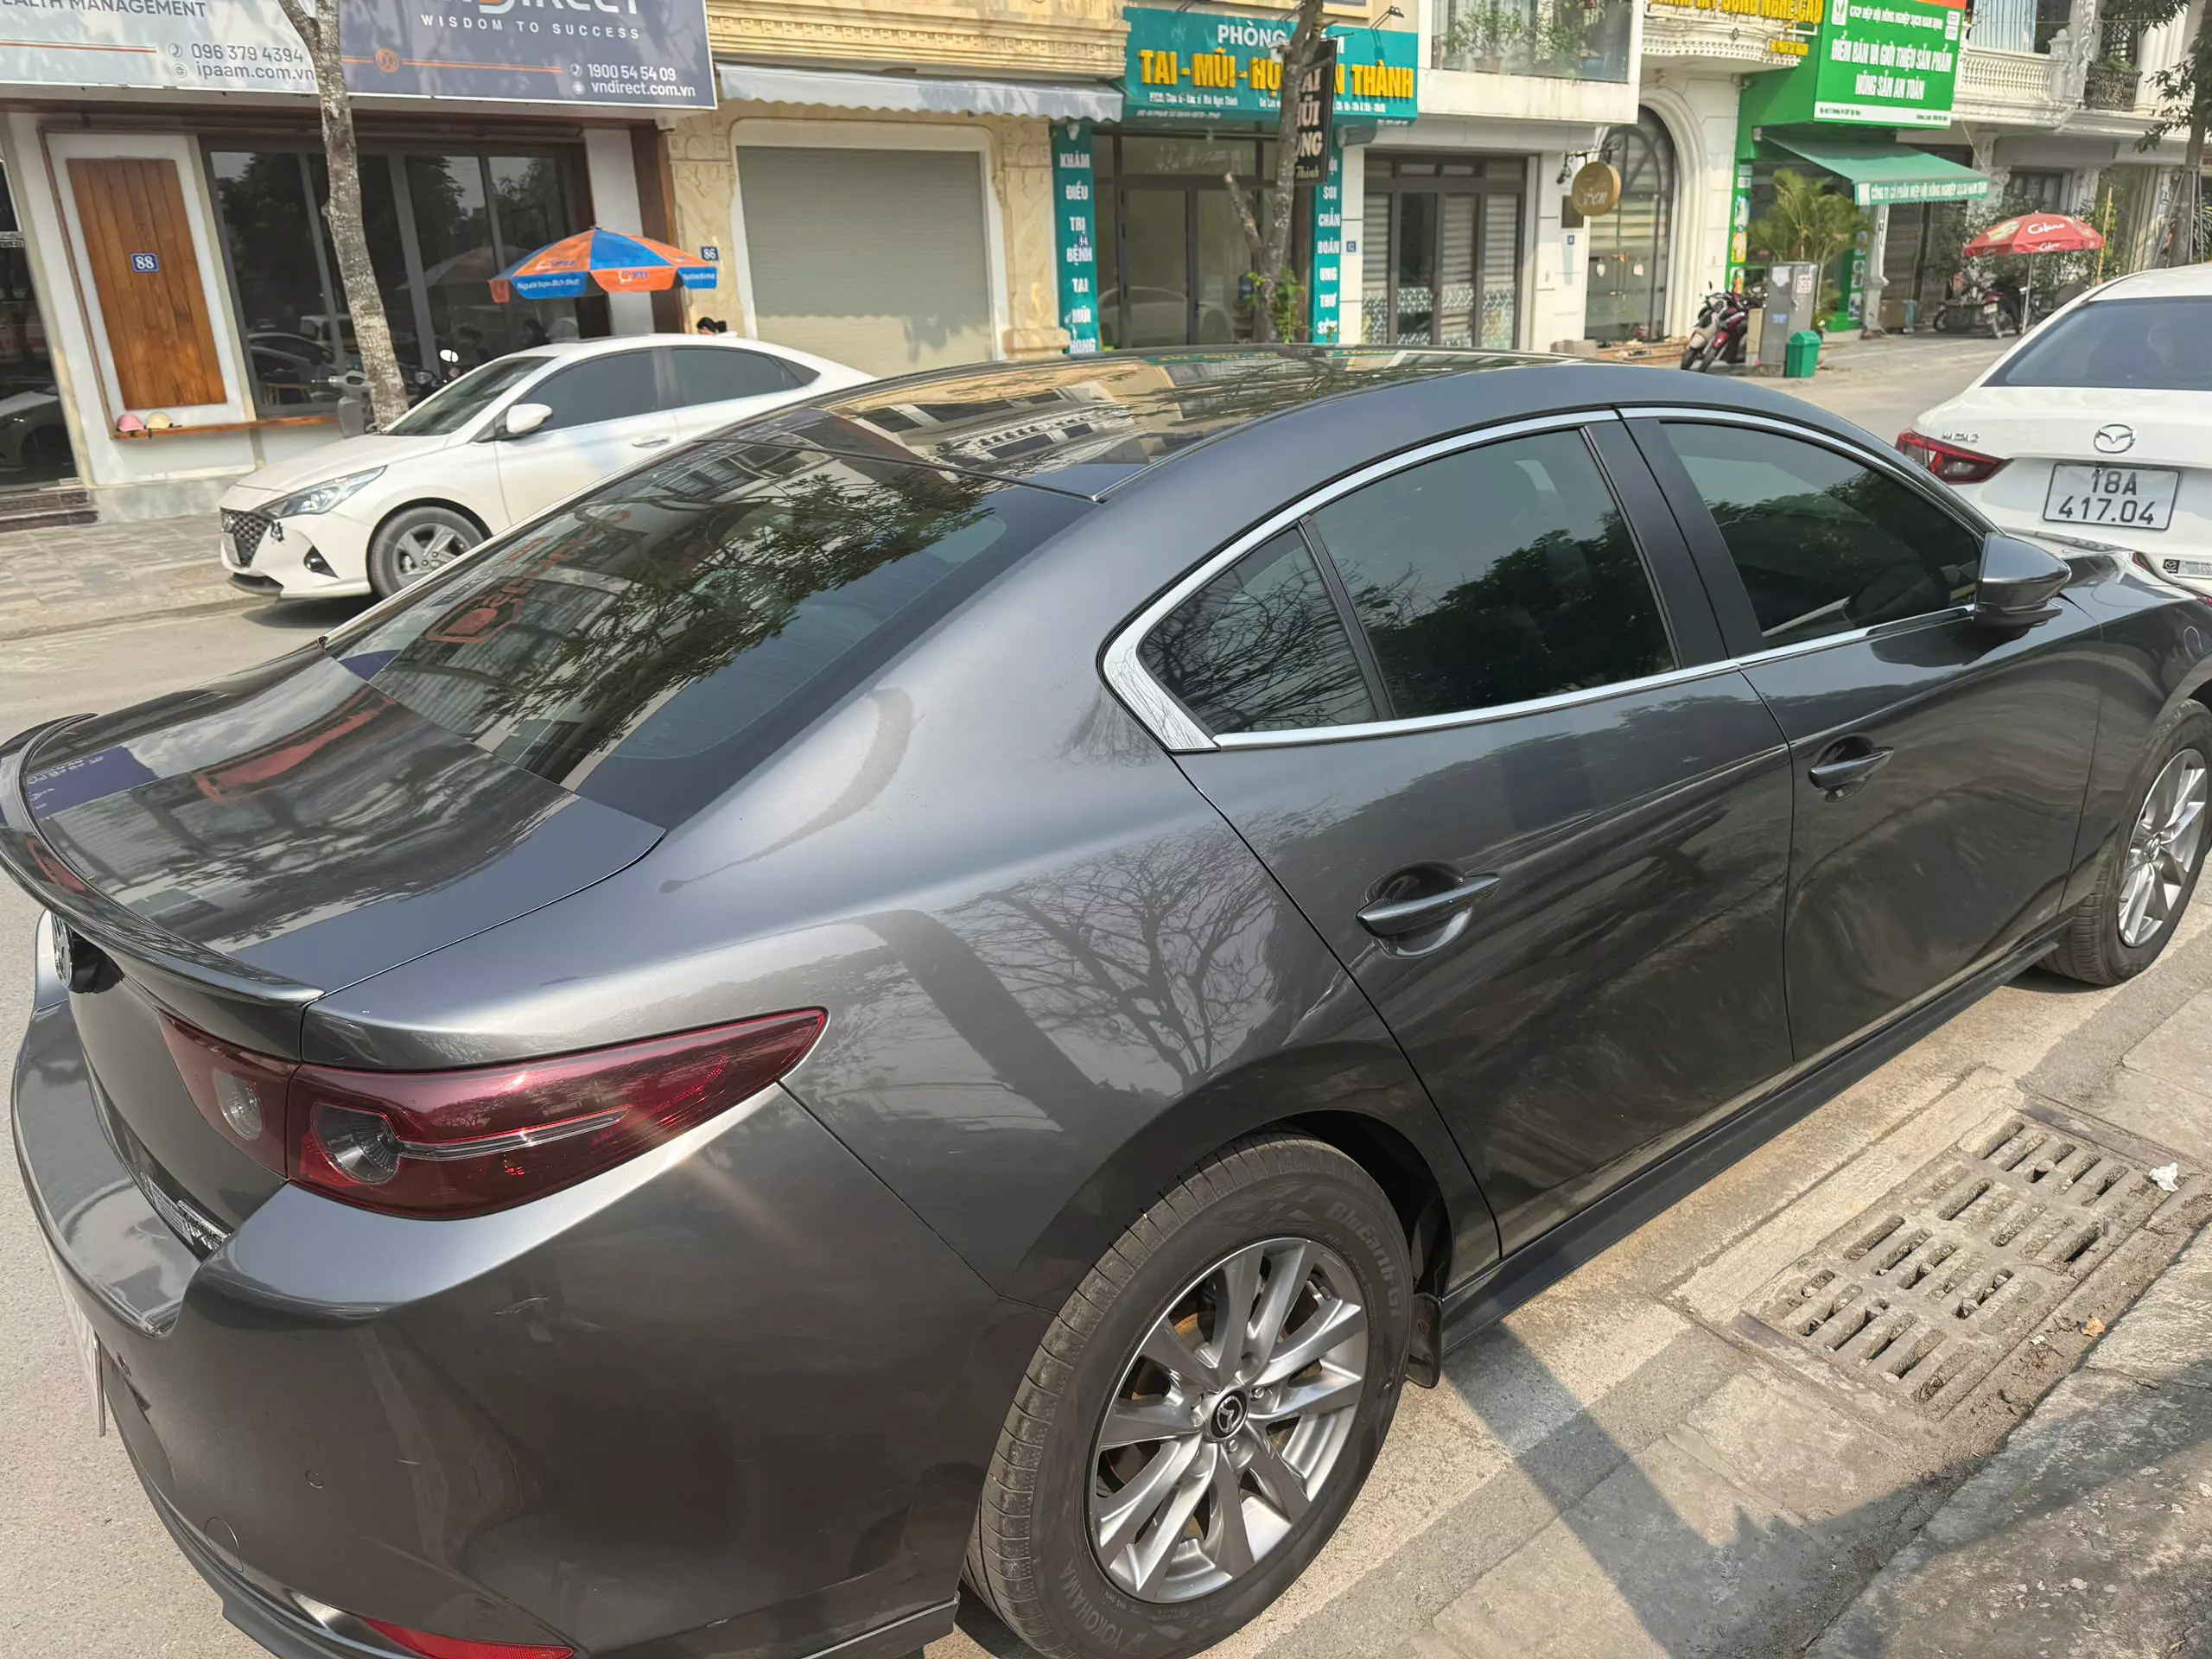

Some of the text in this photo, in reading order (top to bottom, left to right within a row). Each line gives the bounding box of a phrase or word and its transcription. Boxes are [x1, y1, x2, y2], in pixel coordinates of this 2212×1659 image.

[421, 14, 640, 40] WISDOM TO SUCCESS
[1217, 21, 1287, 49] PHÒNG
[191, 44, 303, 63] 096 379 4394
[197, 61, 315, 81] ipaam.com.vn
[588, 64, 676, 81] 1900 54 54 09
[1250, 57, 1283, 98] HỌ
[1351, 60, 1414, 98] THÀNH
[1301, 67, 1322, 92] AI
[591, 81, 696, 98] vndirect.com.vn
[1299, 131, 1323, 157] NG
[1059, 150, 1090, 168] KHÁM
[1328, 156, 1338, 175] ỘI
[1323, 186, 1338, 200] SOI
[136, 256, 155, 270] 88
[703, 248, 715, 259] 86
[1066, 244, 1093, 266] BỆNH
[1071, 277, 1089, 293] TAI
[2090, 470, 2137, 497] 18A
[2058, 495, 2156, 525] 417.04
[1059, 1559, 1124, 1649] YOKOHAMA
